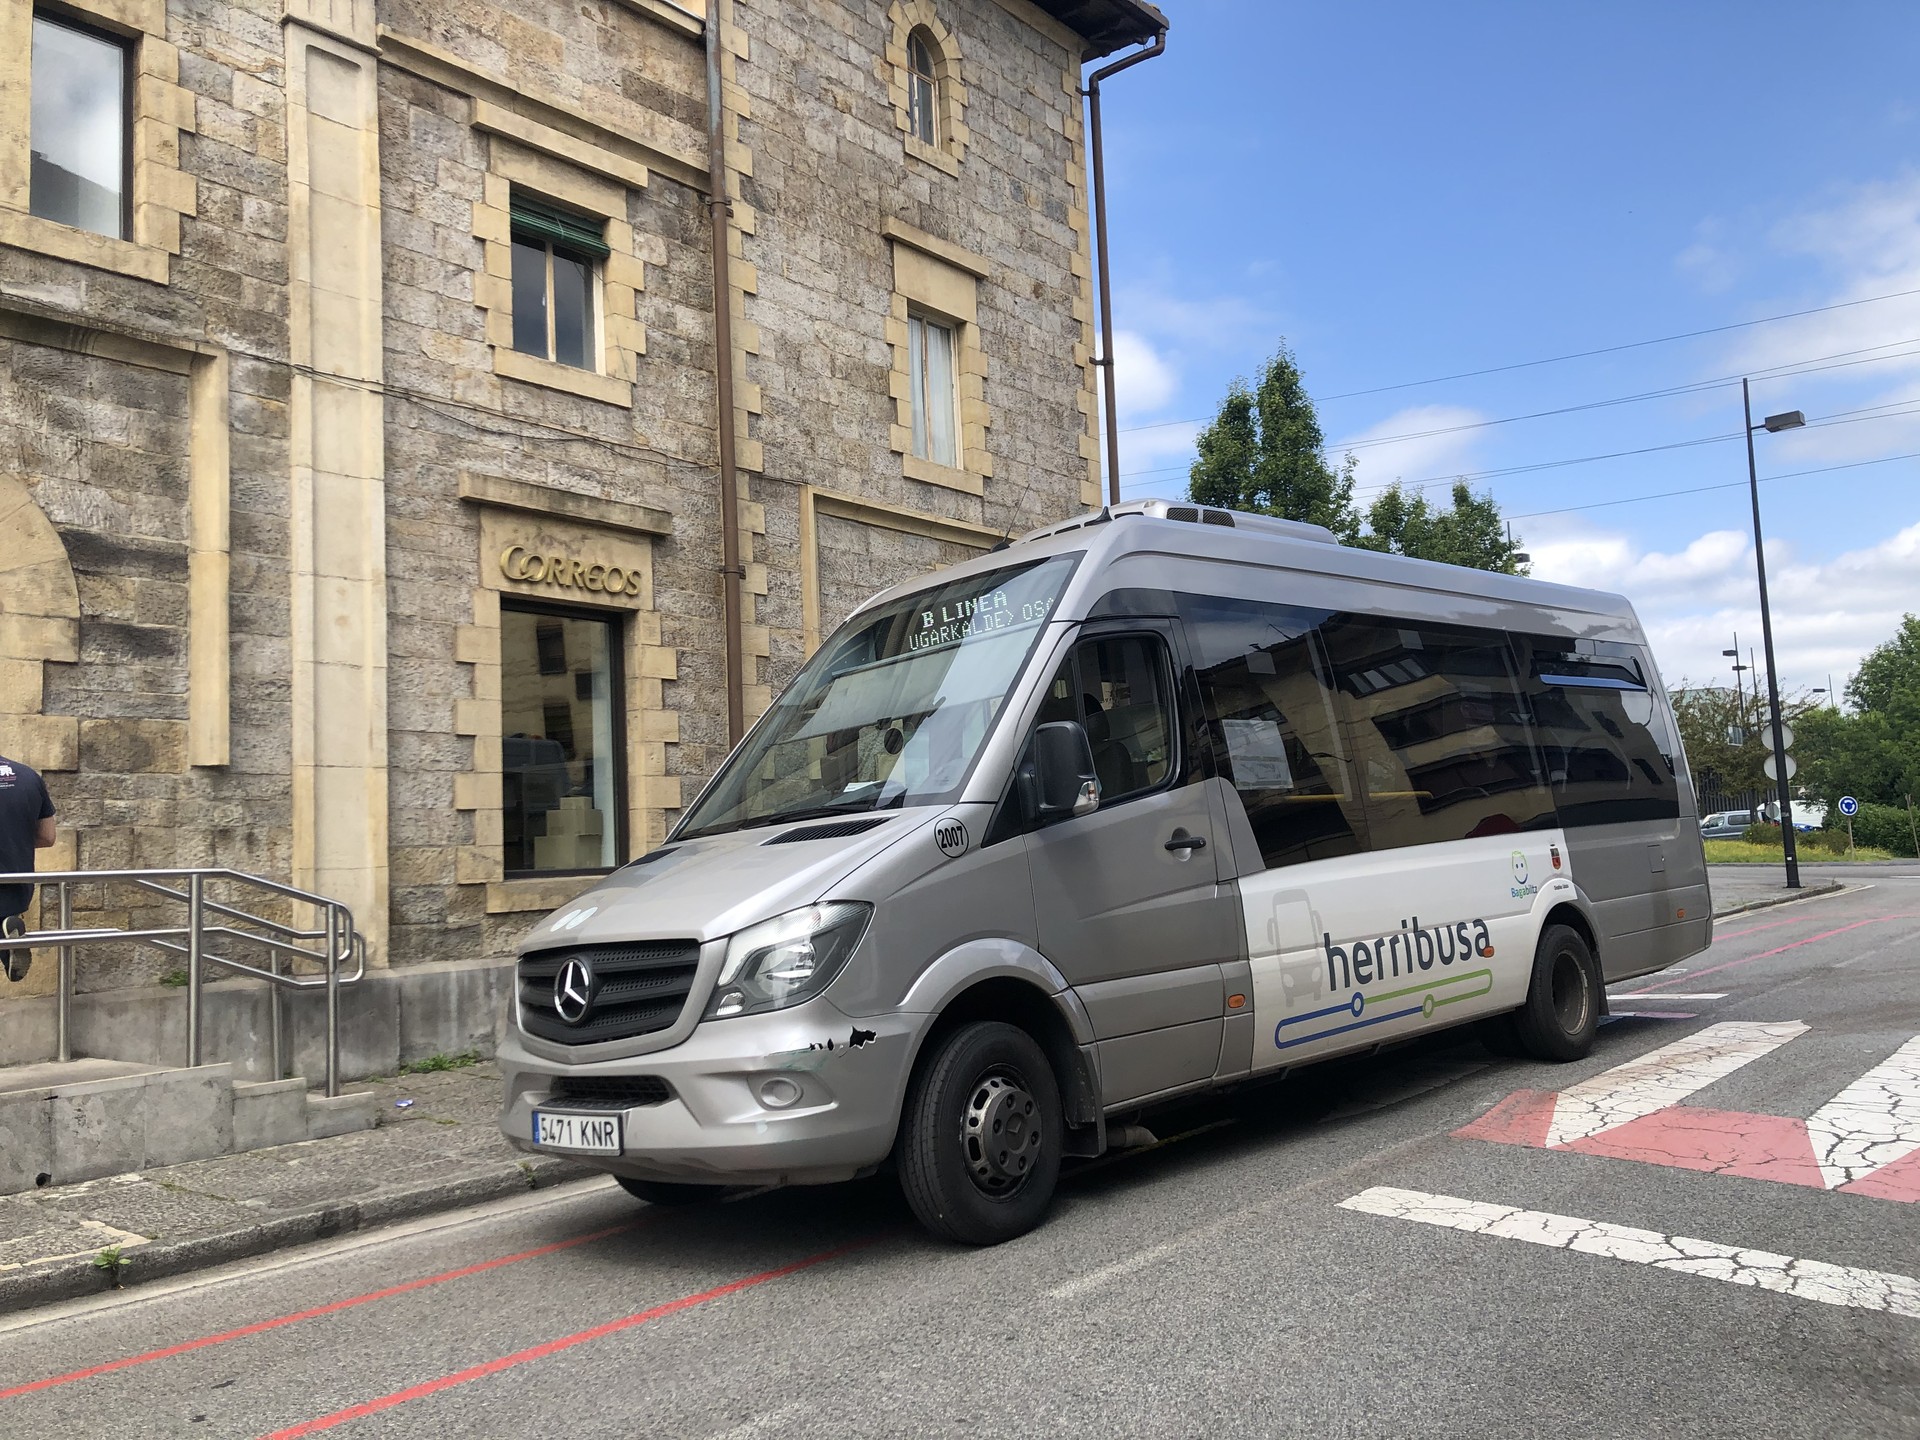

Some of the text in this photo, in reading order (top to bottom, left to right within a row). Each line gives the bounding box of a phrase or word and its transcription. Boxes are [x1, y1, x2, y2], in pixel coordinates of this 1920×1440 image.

[499, 545, 642, 596] CORREOS
[921, 590, 1008, 628] B LINEA
[937, 825, 964, 849] 2007
[1323, 916, 1491, 992] herribusa
[540, 1117, 615, 1147] 5471 KNR
